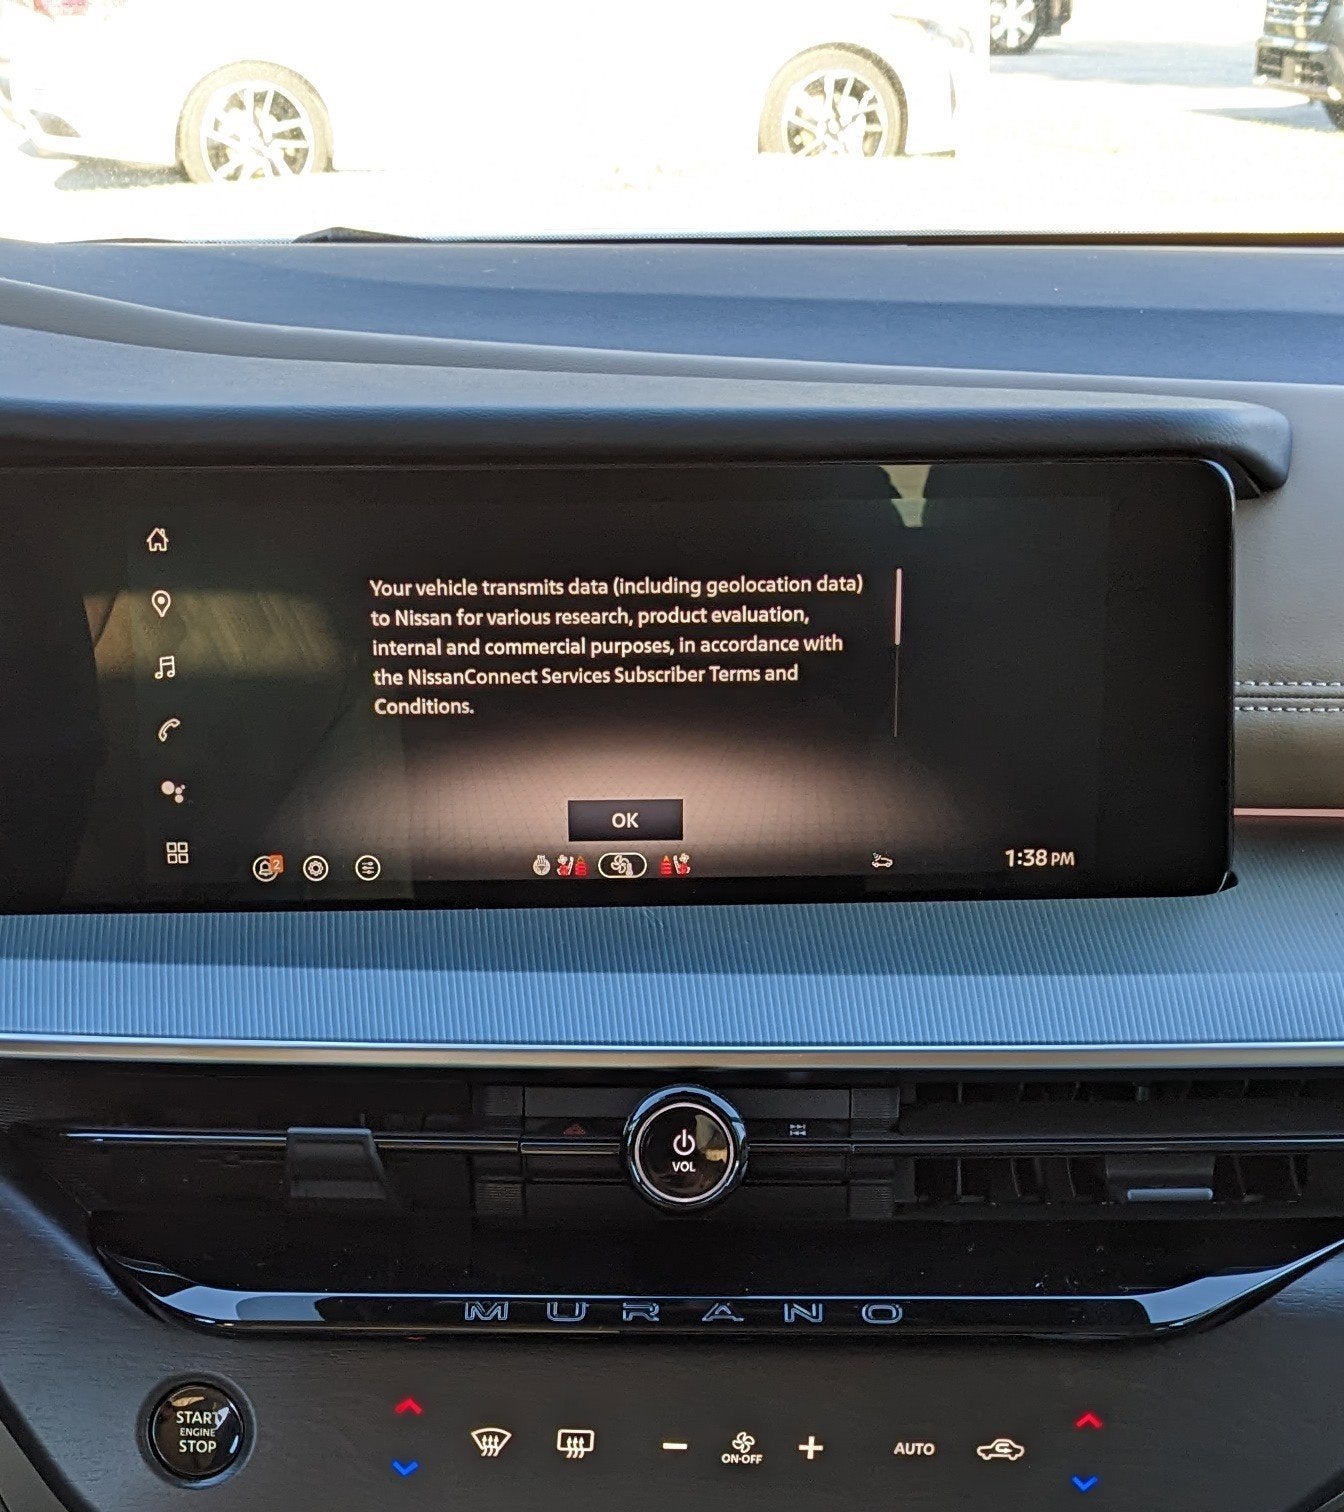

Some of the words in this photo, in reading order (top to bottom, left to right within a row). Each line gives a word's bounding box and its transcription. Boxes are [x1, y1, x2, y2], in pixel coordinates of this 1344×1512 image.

[369, 578, 413, 597] Your
[416, 578, 478, 597] vehicle
[482, 577, 564, 596] transmits
[567, 577, 609, 596] data
[613, 576, 702, 598] (including
[706, 575, 813, 598] geolocation
[816, 574, 864, 595] data)
[370, 610, 391, 627] to
[395, 609, 453, 627] Nissan
[456, 608, 484, 627] for
[486, 608, 552, 626] various
[555, 607, 634, 628] research,
[637, 606, 708, 629] product
[711, 605, 810, 625] evaluation,
[372, 638, 442, 656] internal
[446, 638, 481, 656] and
[484, 637, 586, 656] commercial
[590, 640, 675, 658] purposes,
[679, 637, 696, 654] in
[700, 635, 800, 653] accordance
[803, 634, 844, 652] with
[373, 668, 404, 686] the
[408, 668, 539, 686] NissanConnect
[541, 667, 611, 685] Services
[614, 665, 706, 684] Subscriber
[709, 664, 761, 682] Terms
[764, 664, 799, 682] and
[374, 697, 475, 716] Conditions.
[611, 812, 639, 829] OK
[271, 858, 281, 871] 2
[1005, 848, 1048, 868] 1:38
[1050, 851, 1075, 867] PM
[672, 1161, 696, 1173] VOL
[464, 1301, 905, 1325] MURANO
[176, 1410, 221, 1424] START
[179, 1427, 216, 1438] ENGINE
[178, 1439, 217, 1454] STOP
[893, 1442, 936, 1456] AUTO
